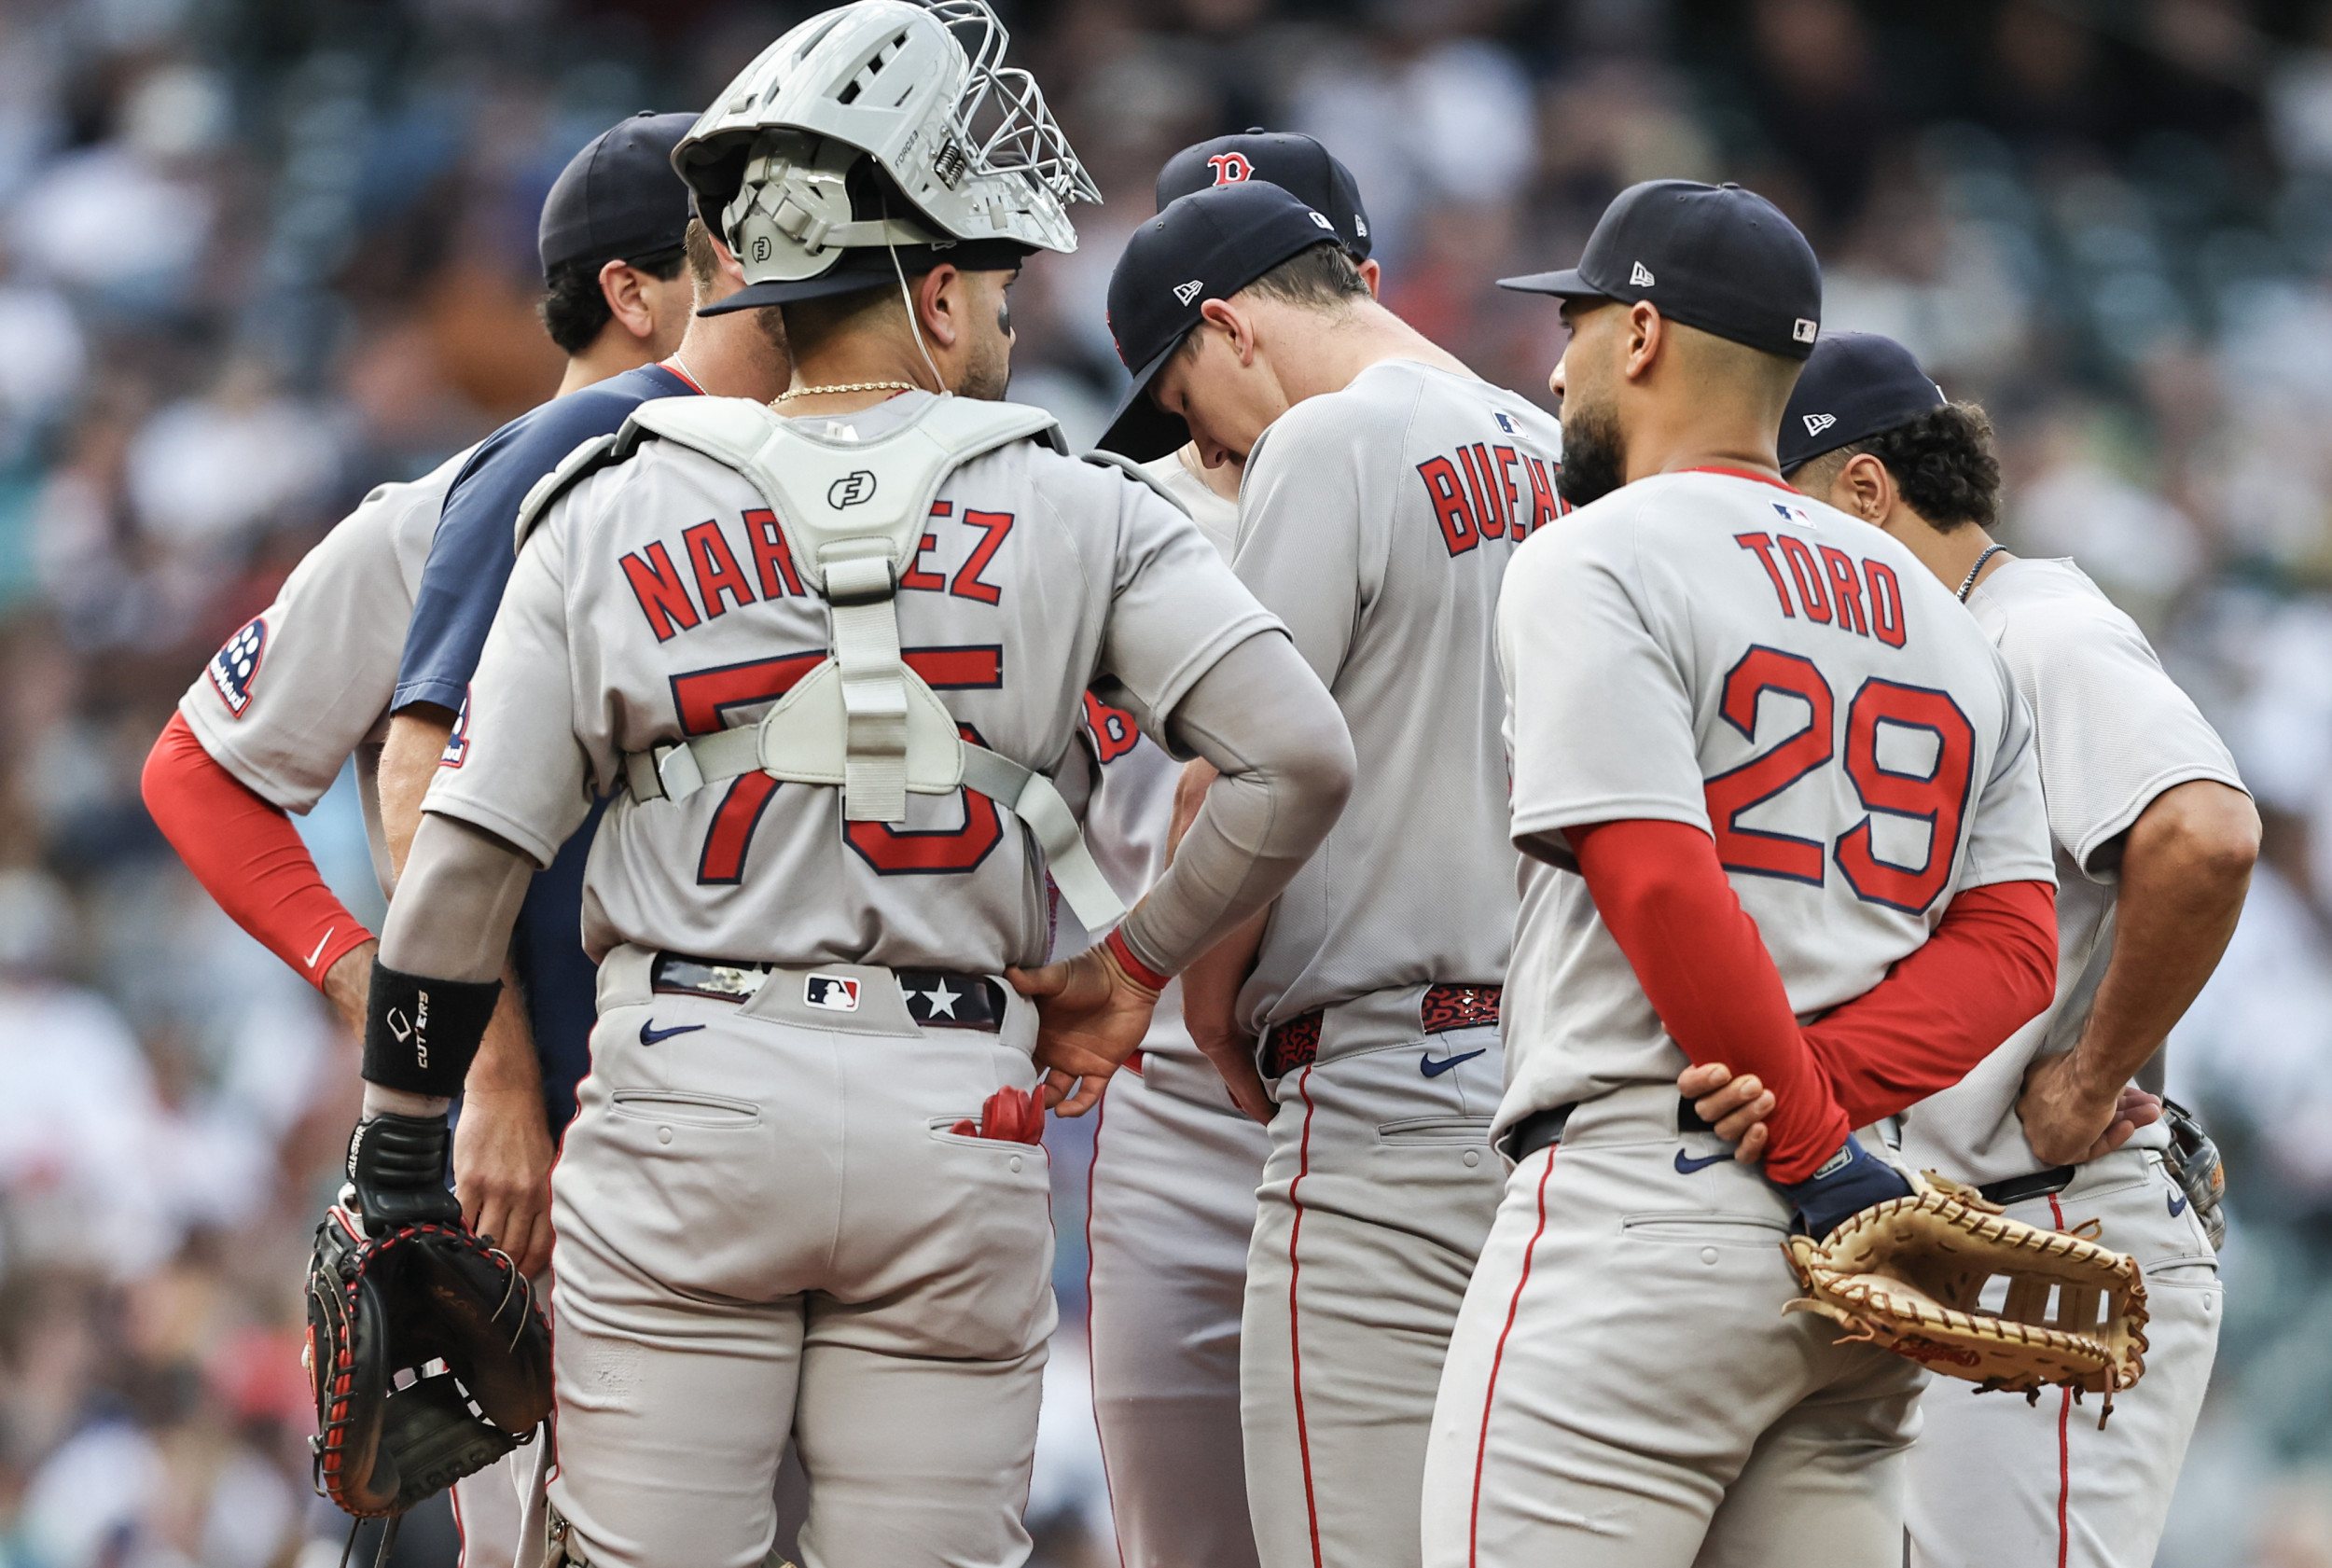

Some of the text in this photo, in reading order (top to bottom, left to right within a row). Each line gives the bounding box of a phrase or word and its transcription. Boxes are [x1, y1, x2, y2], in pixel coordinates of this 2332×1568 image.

[1415, 442, 1573, 559] BUEH
[619, 500, 1016, 644] NAREZ
[1732, 531, 1908, 650] TORO
[1702, 643, 1976, 917] 29
[414, 989, 430, 1070] CUTERS
